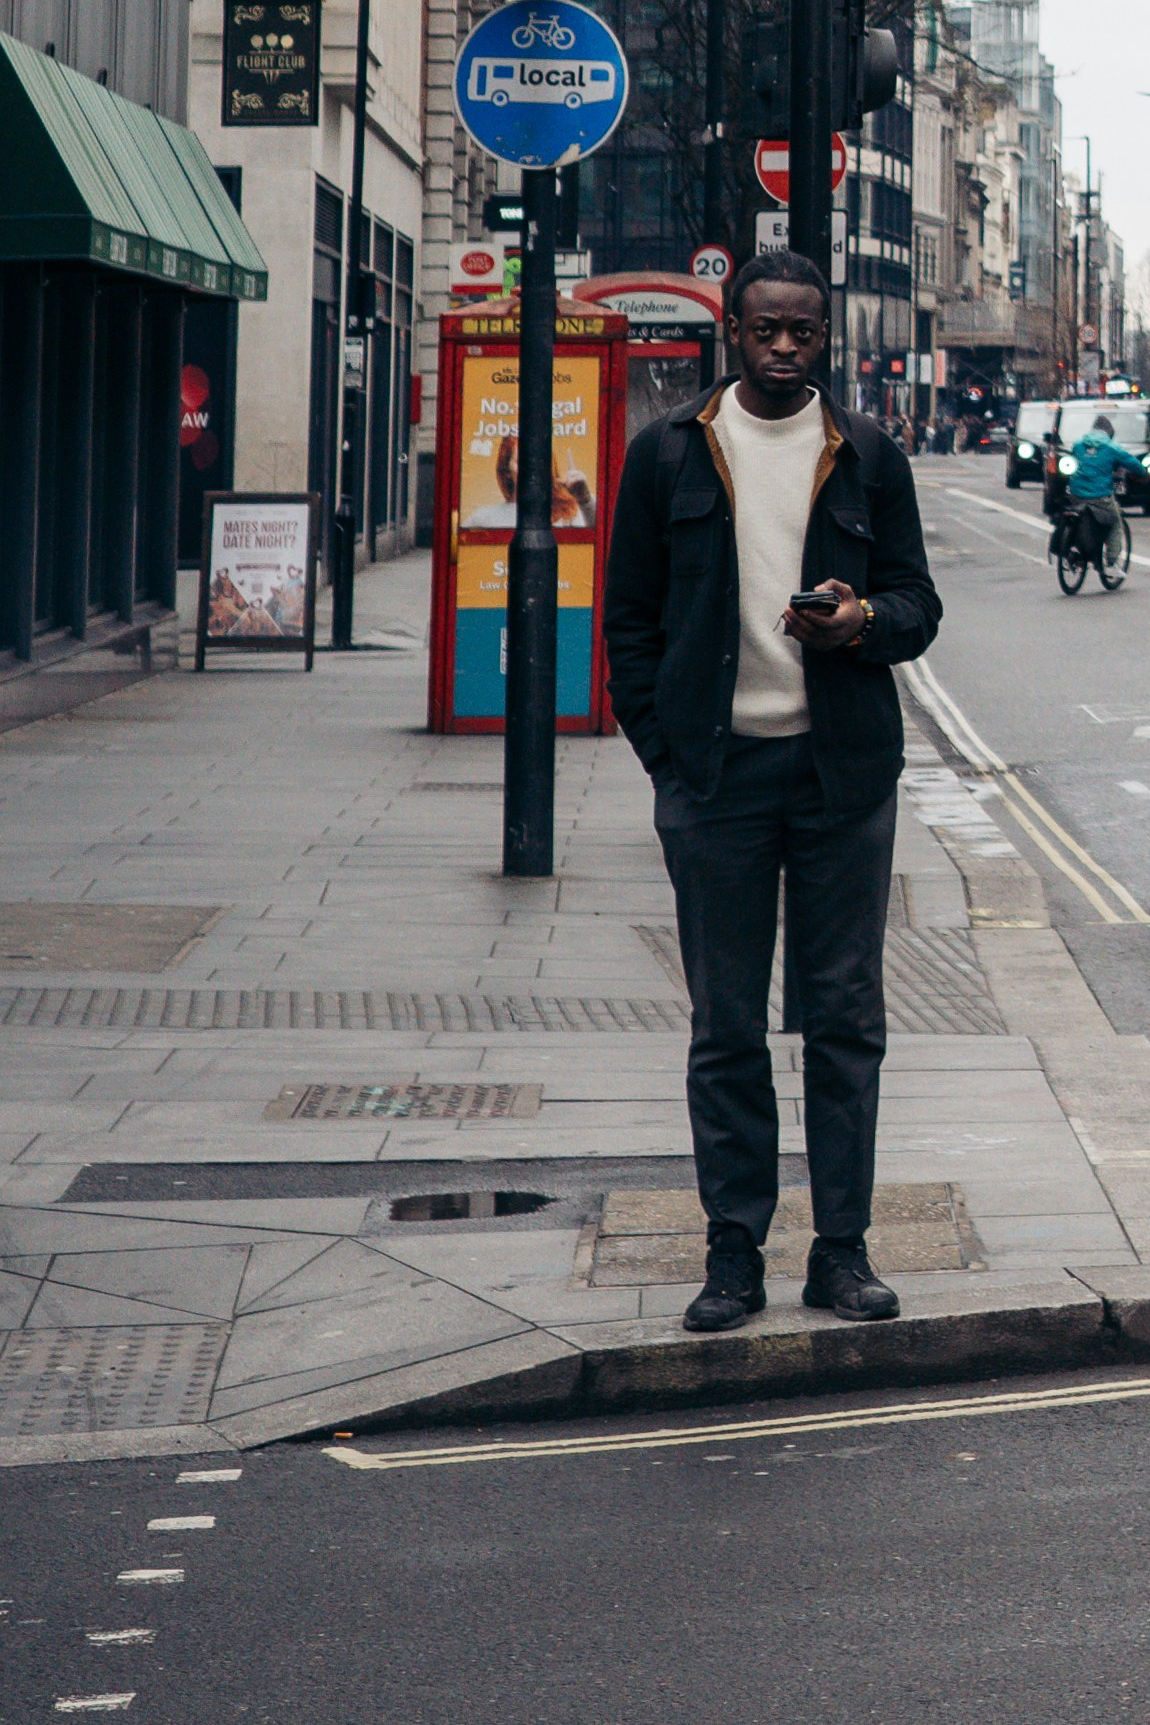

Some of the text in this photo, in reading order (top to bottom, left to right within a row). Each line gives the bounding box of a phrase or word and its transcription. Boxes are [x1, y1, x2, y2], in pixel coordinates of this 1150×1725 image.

[237, 55, 306, 69] FLIGHT CLUB
[520, 63, 586, 87] local
[696, 257, 727, 276] 20
[615, 300, 679, 316] Telephone
[651, 326, 685, 339] Cards
[552, 396, 582, 421] gal
[552, 418, 587, 437] ard
[223, 520, 299, 534] MATES NIGHT?
[223, 534, 297, 549] DATE NIGHT?
